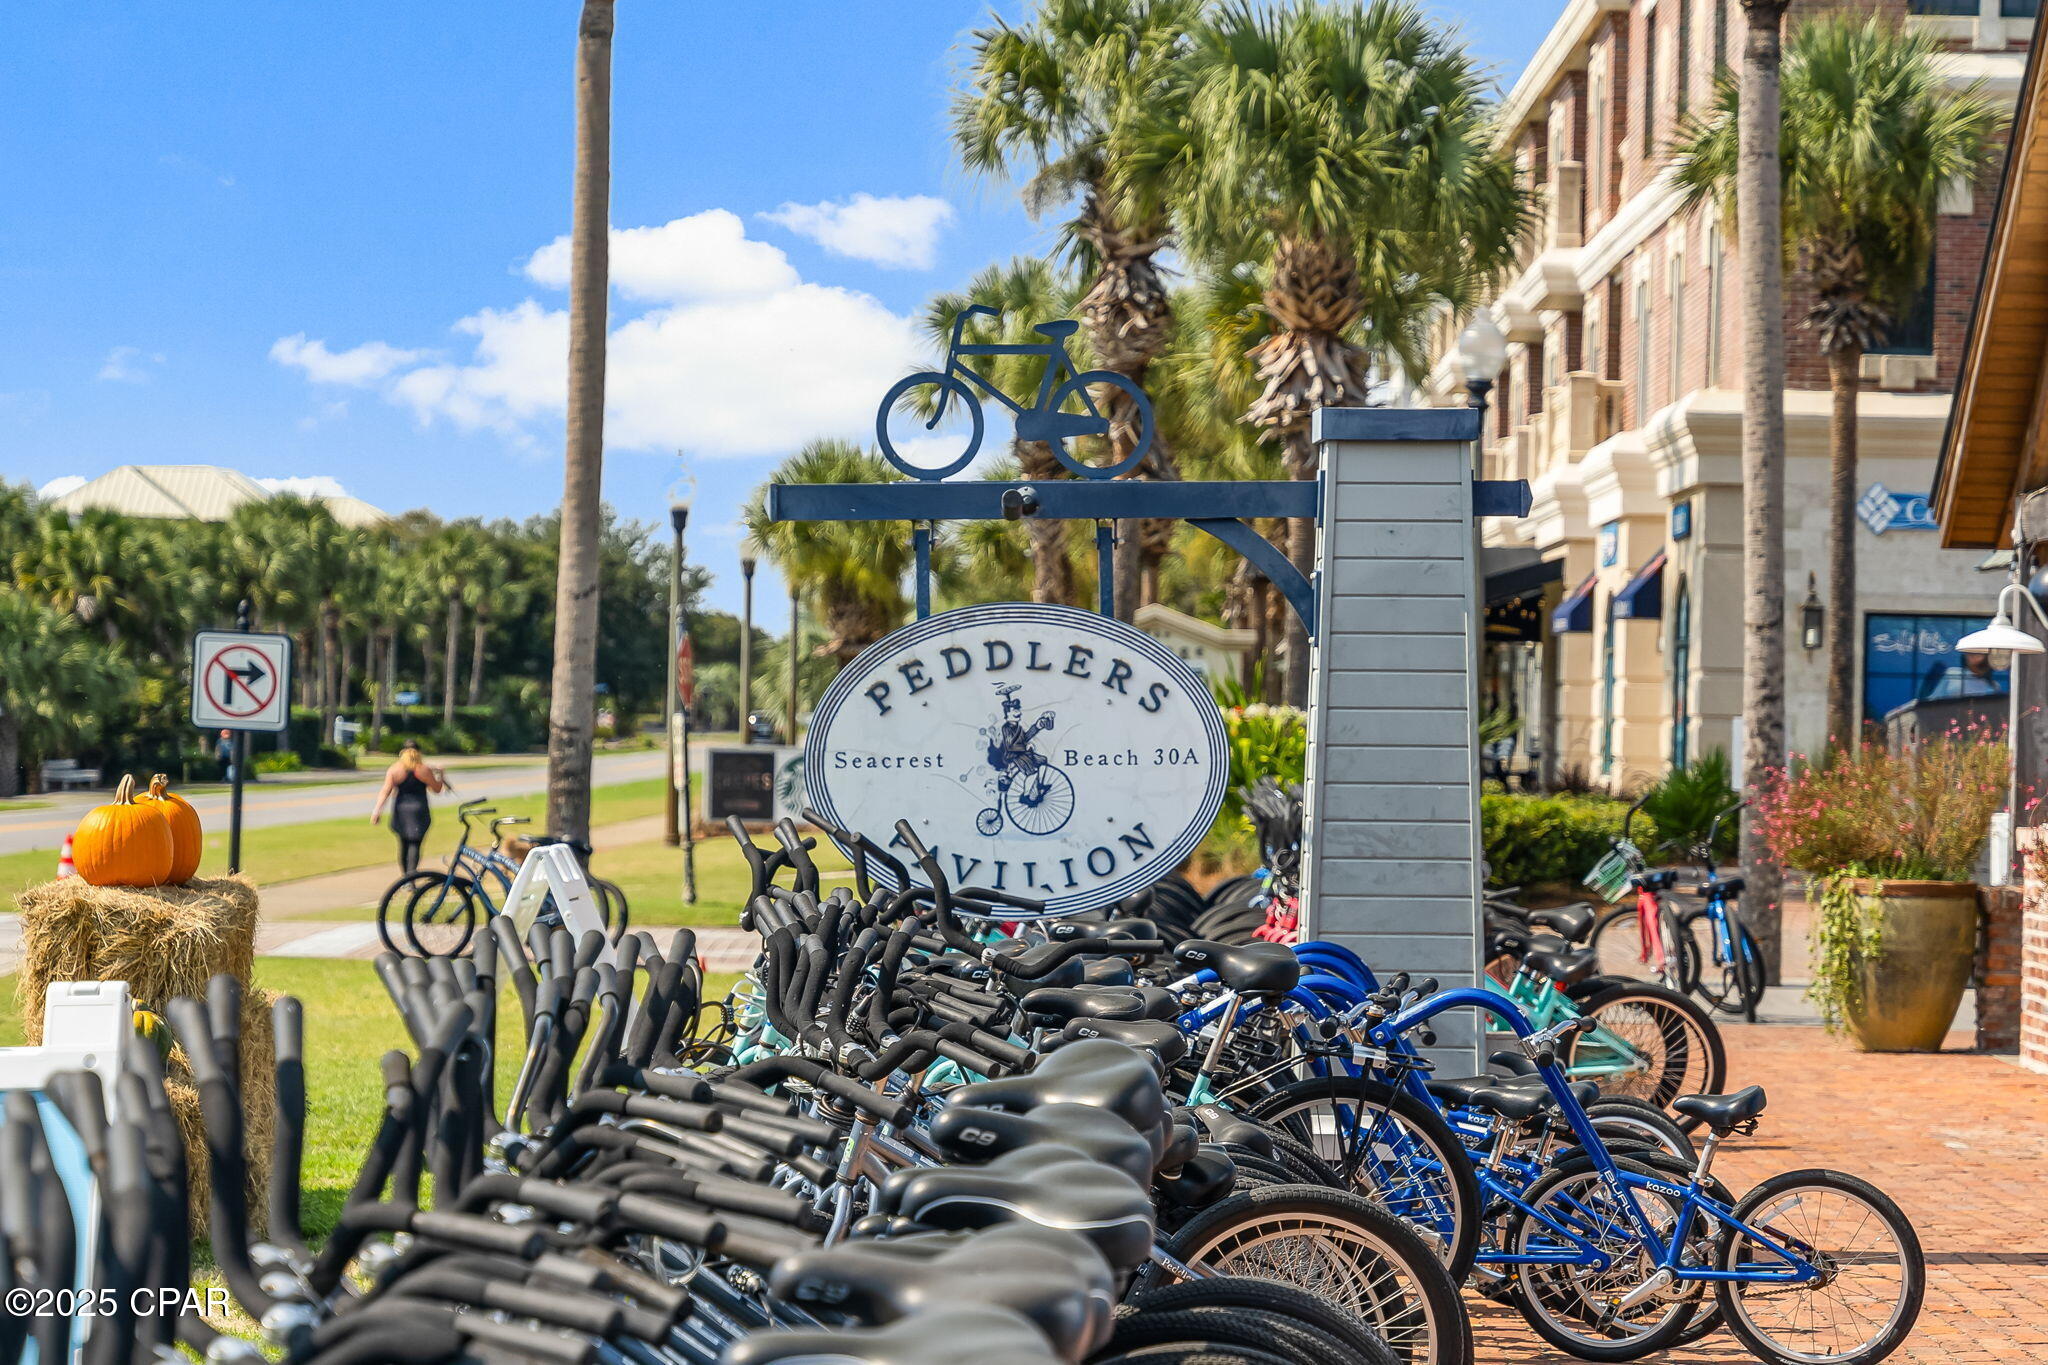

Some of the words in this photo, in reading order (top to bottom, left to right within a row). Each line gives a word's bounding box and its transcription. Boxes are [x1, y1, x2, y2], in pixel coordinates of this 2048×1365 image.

[864, 640, 1169, 716] PEDDLERS
[835, 752, 944, 768] Seacrest
[1064, 749, 1139, 767] Beach
[1154, 748, 1199, 766] 30A
[889, 822, 1155, 893] VILION
[1055, 926, 1075, 935] C9
[1185, 950, 1207, 961] C9
[1078, 1027, 1100, 1039] C9
[959, 1126, 998, 1147] C9
[1401, 1153, 1442, 1221] BURLEY
[1646, 1181, 1681, 1197] kazoo
[1604, 1170, 1647, 1238] BURLEY
